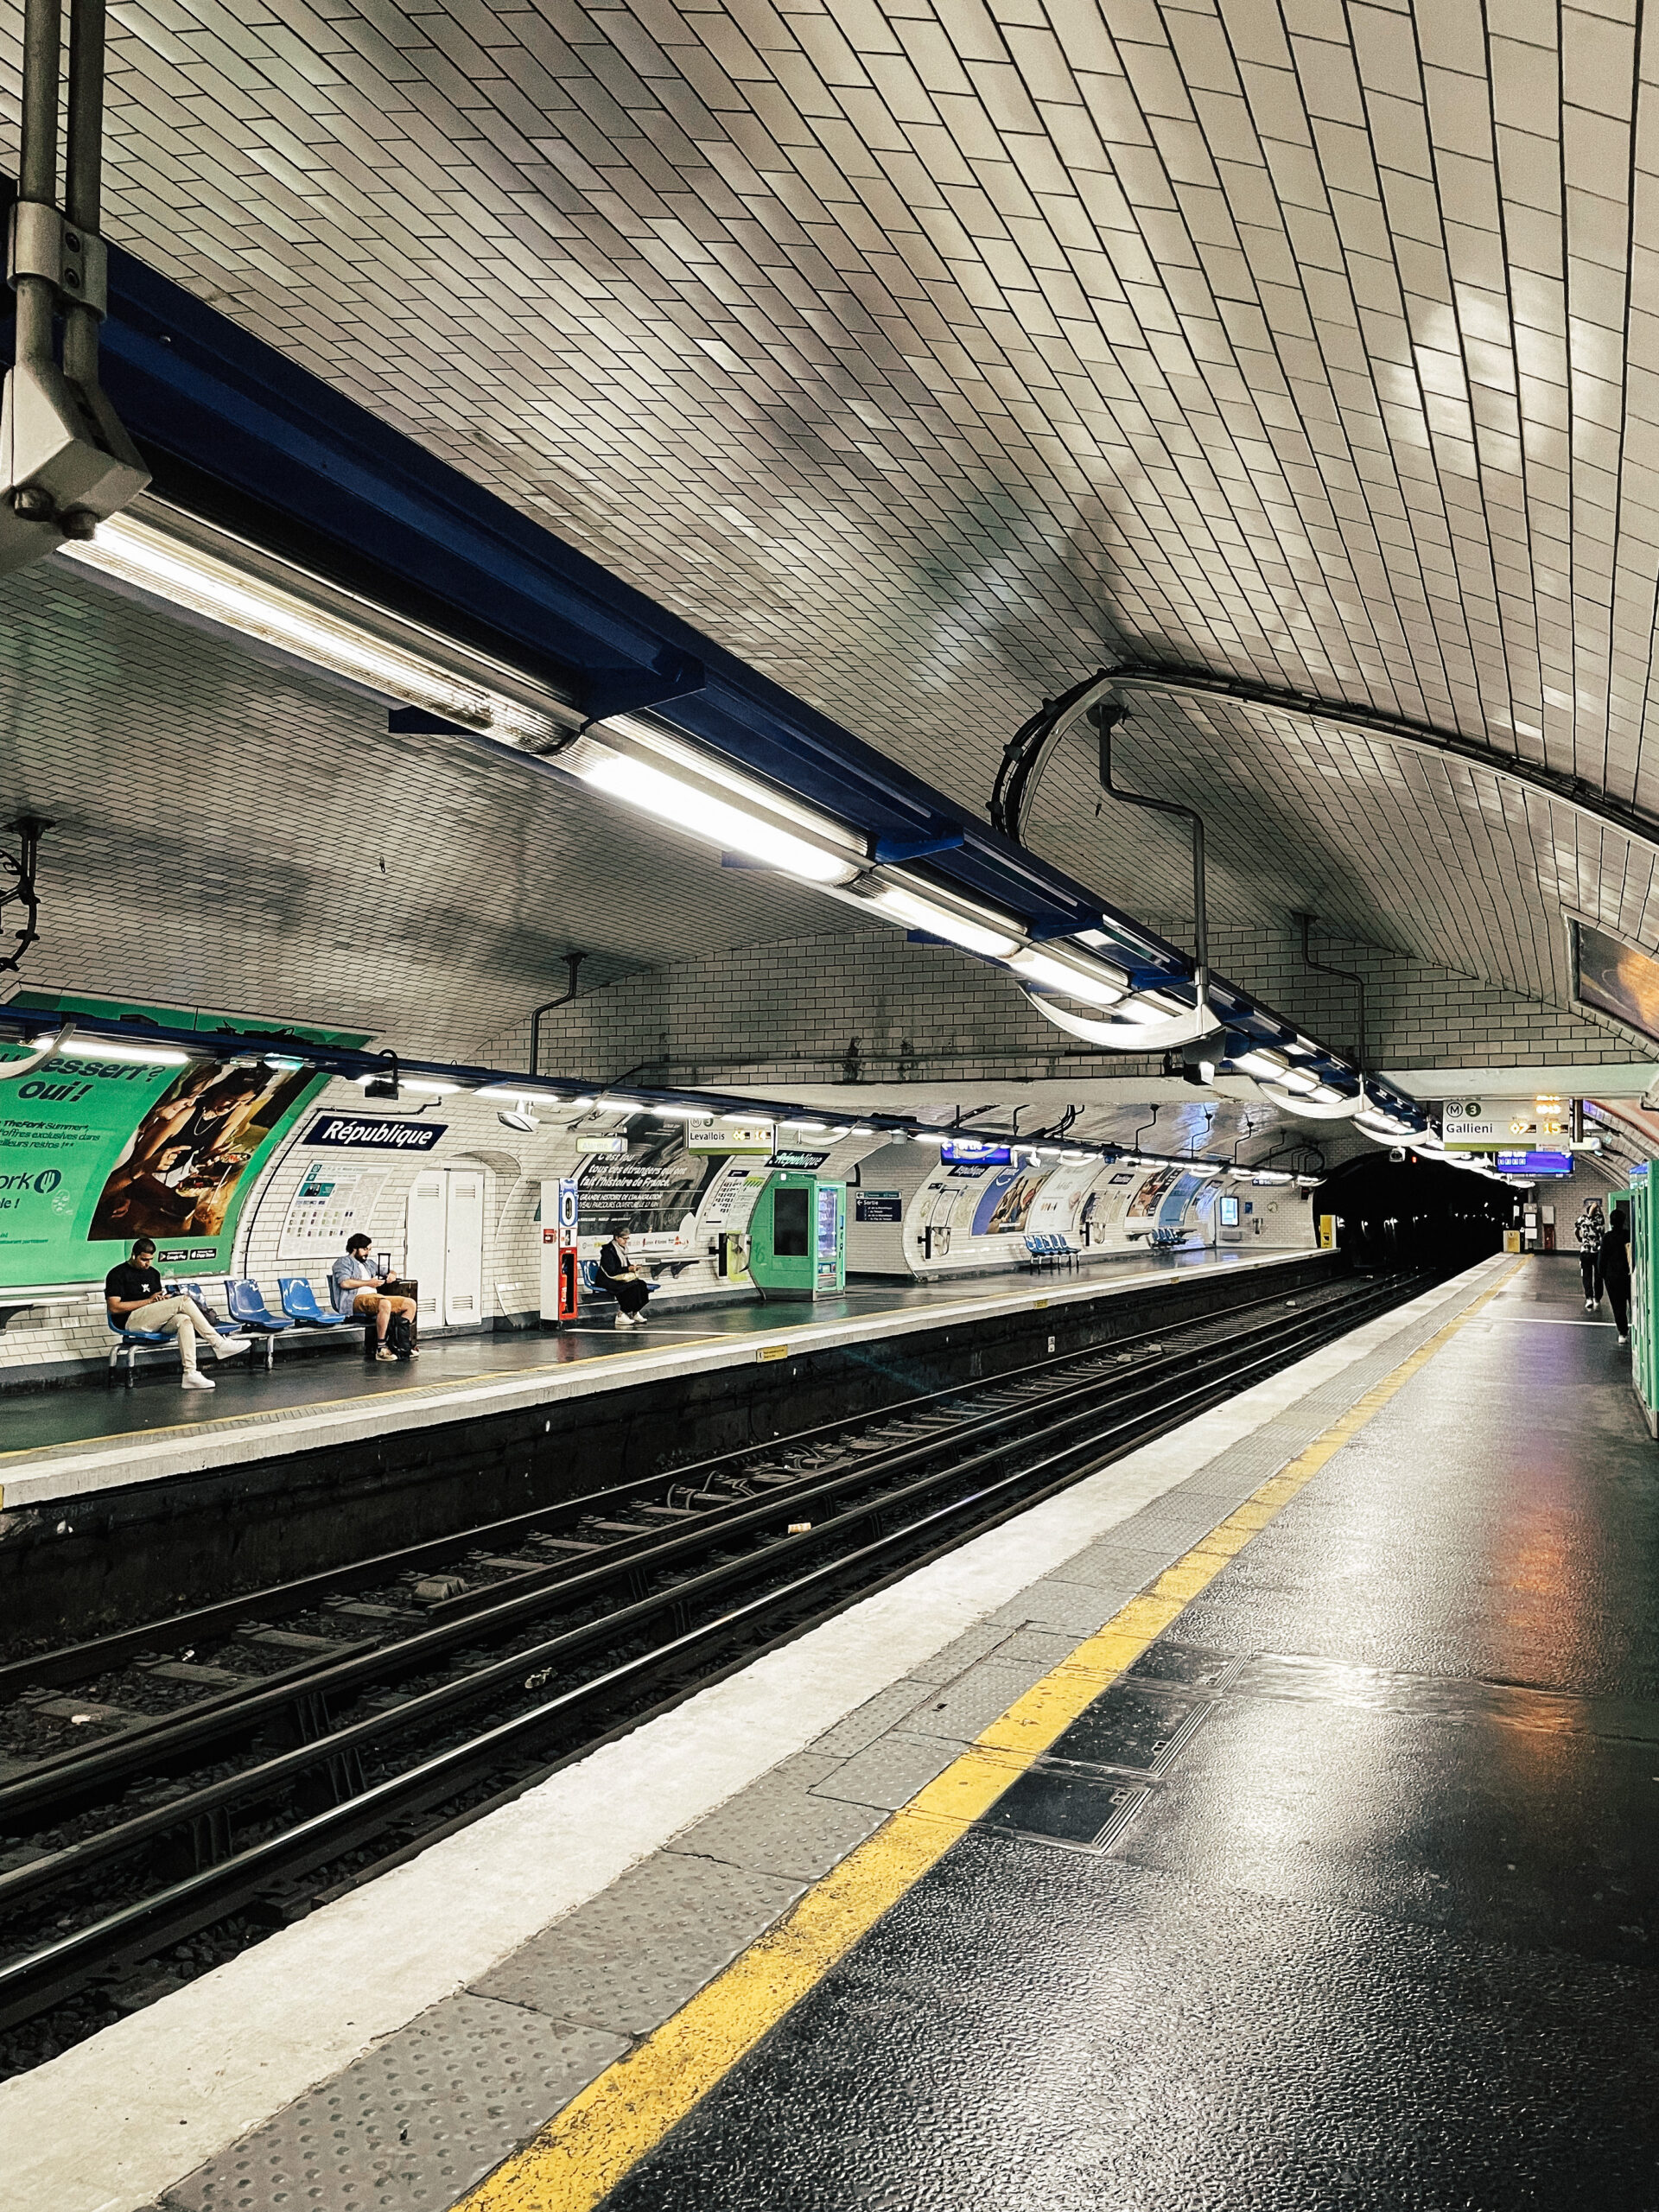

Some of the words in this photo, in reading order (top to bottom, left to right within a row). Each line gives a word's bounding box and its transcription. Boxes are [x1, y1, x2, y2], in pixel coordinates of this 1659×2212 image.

[41, 1058, 148, 1080] essert
[322, 1121, 433, 1147] République
[1446, 1123, 1492, 1133] Gallieni
[1510, 1122, 1529, 1135] 07
[1543, 1122, 1561, 1135] 15
[690, 1131, 725, 1141] Levallois
[588, 1164, 609, 1173] tous
[607, 1166, 624, 1174] ces
[622, 1164, 662, 1177] étrangers
[661, 1166, 677, 1177] qui
[580, 1175, 597, 1186] fait
[595, 1176, 633, 1186] l'histoire
[632, 1177, 644, 1186] de
[642, 1177, 670, 1187] France.
